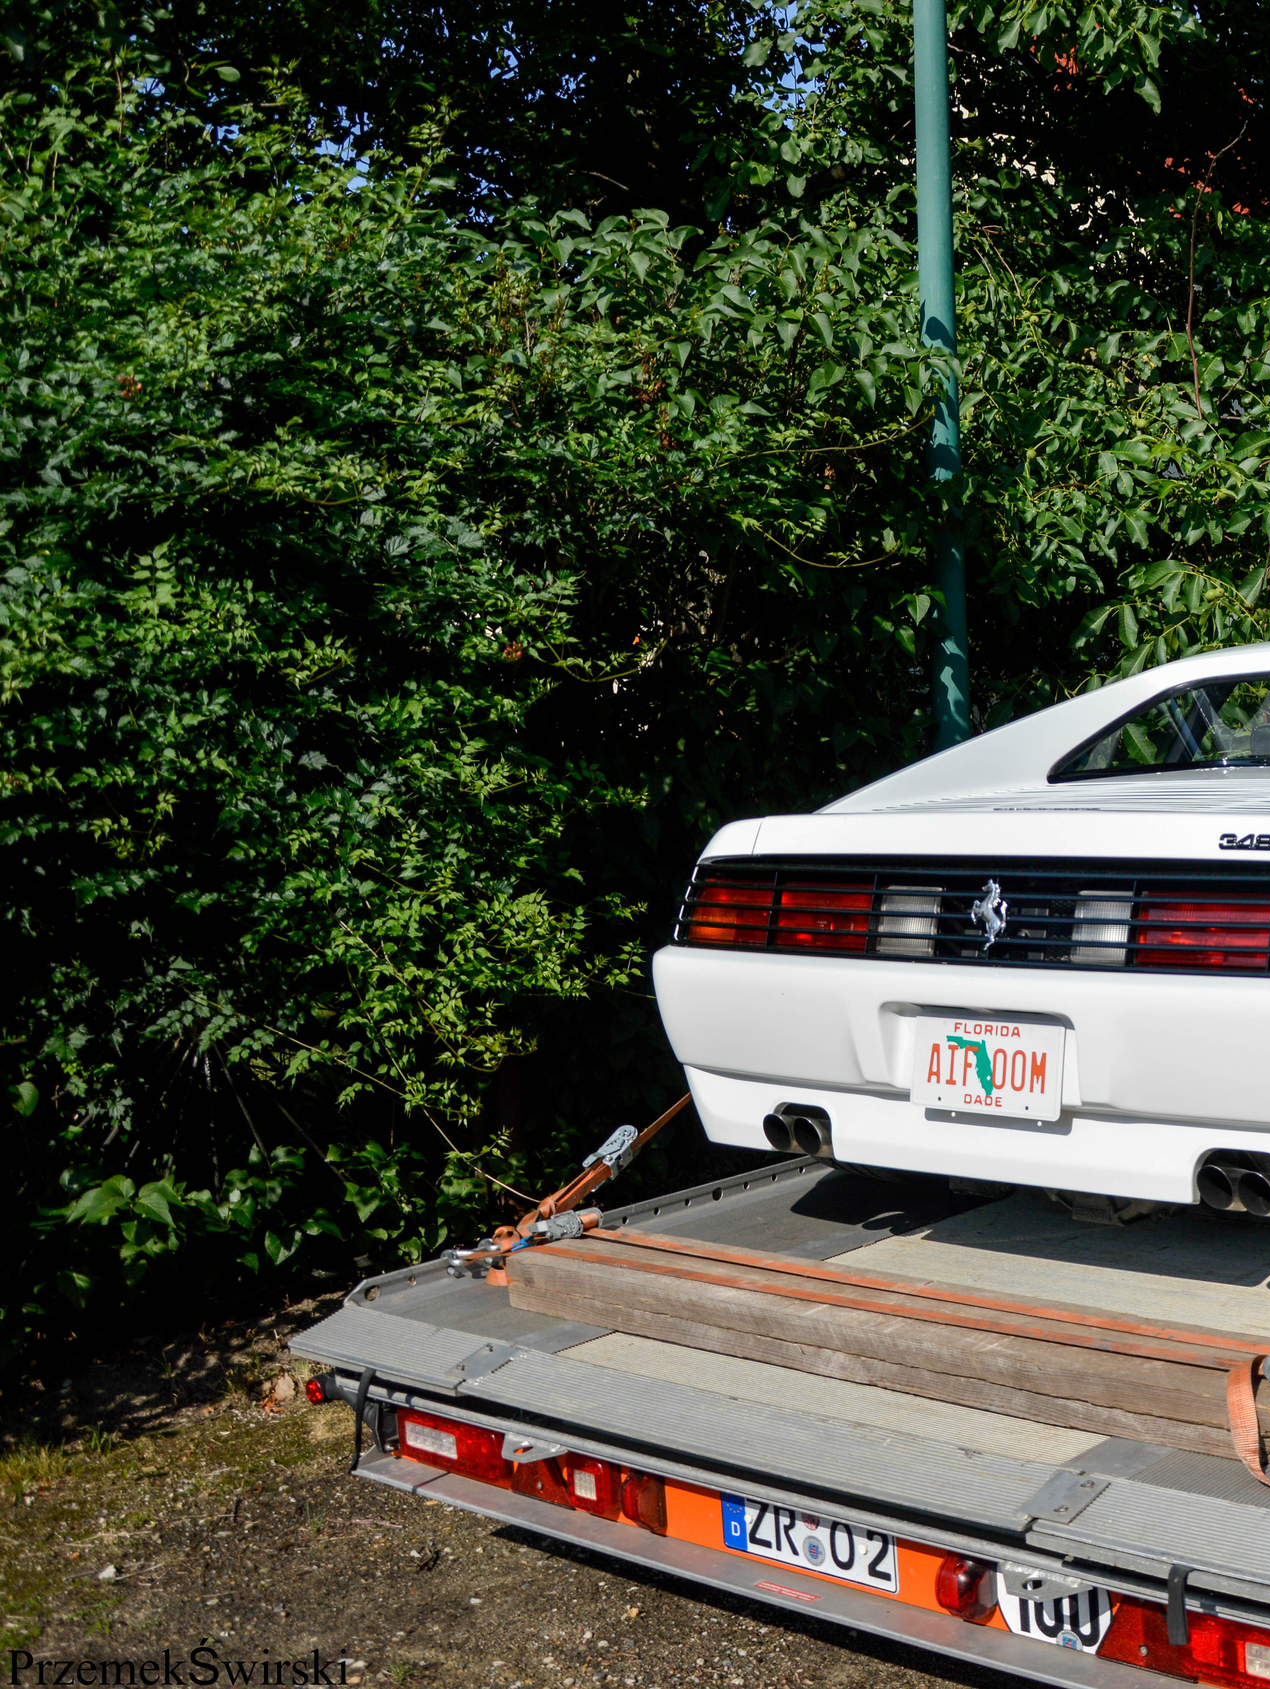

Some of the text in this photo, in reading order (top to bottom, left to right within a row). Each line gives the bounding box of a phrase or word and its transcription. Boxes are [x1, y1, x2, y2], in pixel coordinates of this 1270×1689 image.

[954, 1022, 1021, 1038] FLORIDA
[927, 1043, 979, 1086] AIF
[964, 1093, 1003, 1107] DADE
[731, 1521, 741, 1536] D
[746, 1498, 800, 1556] ZR
